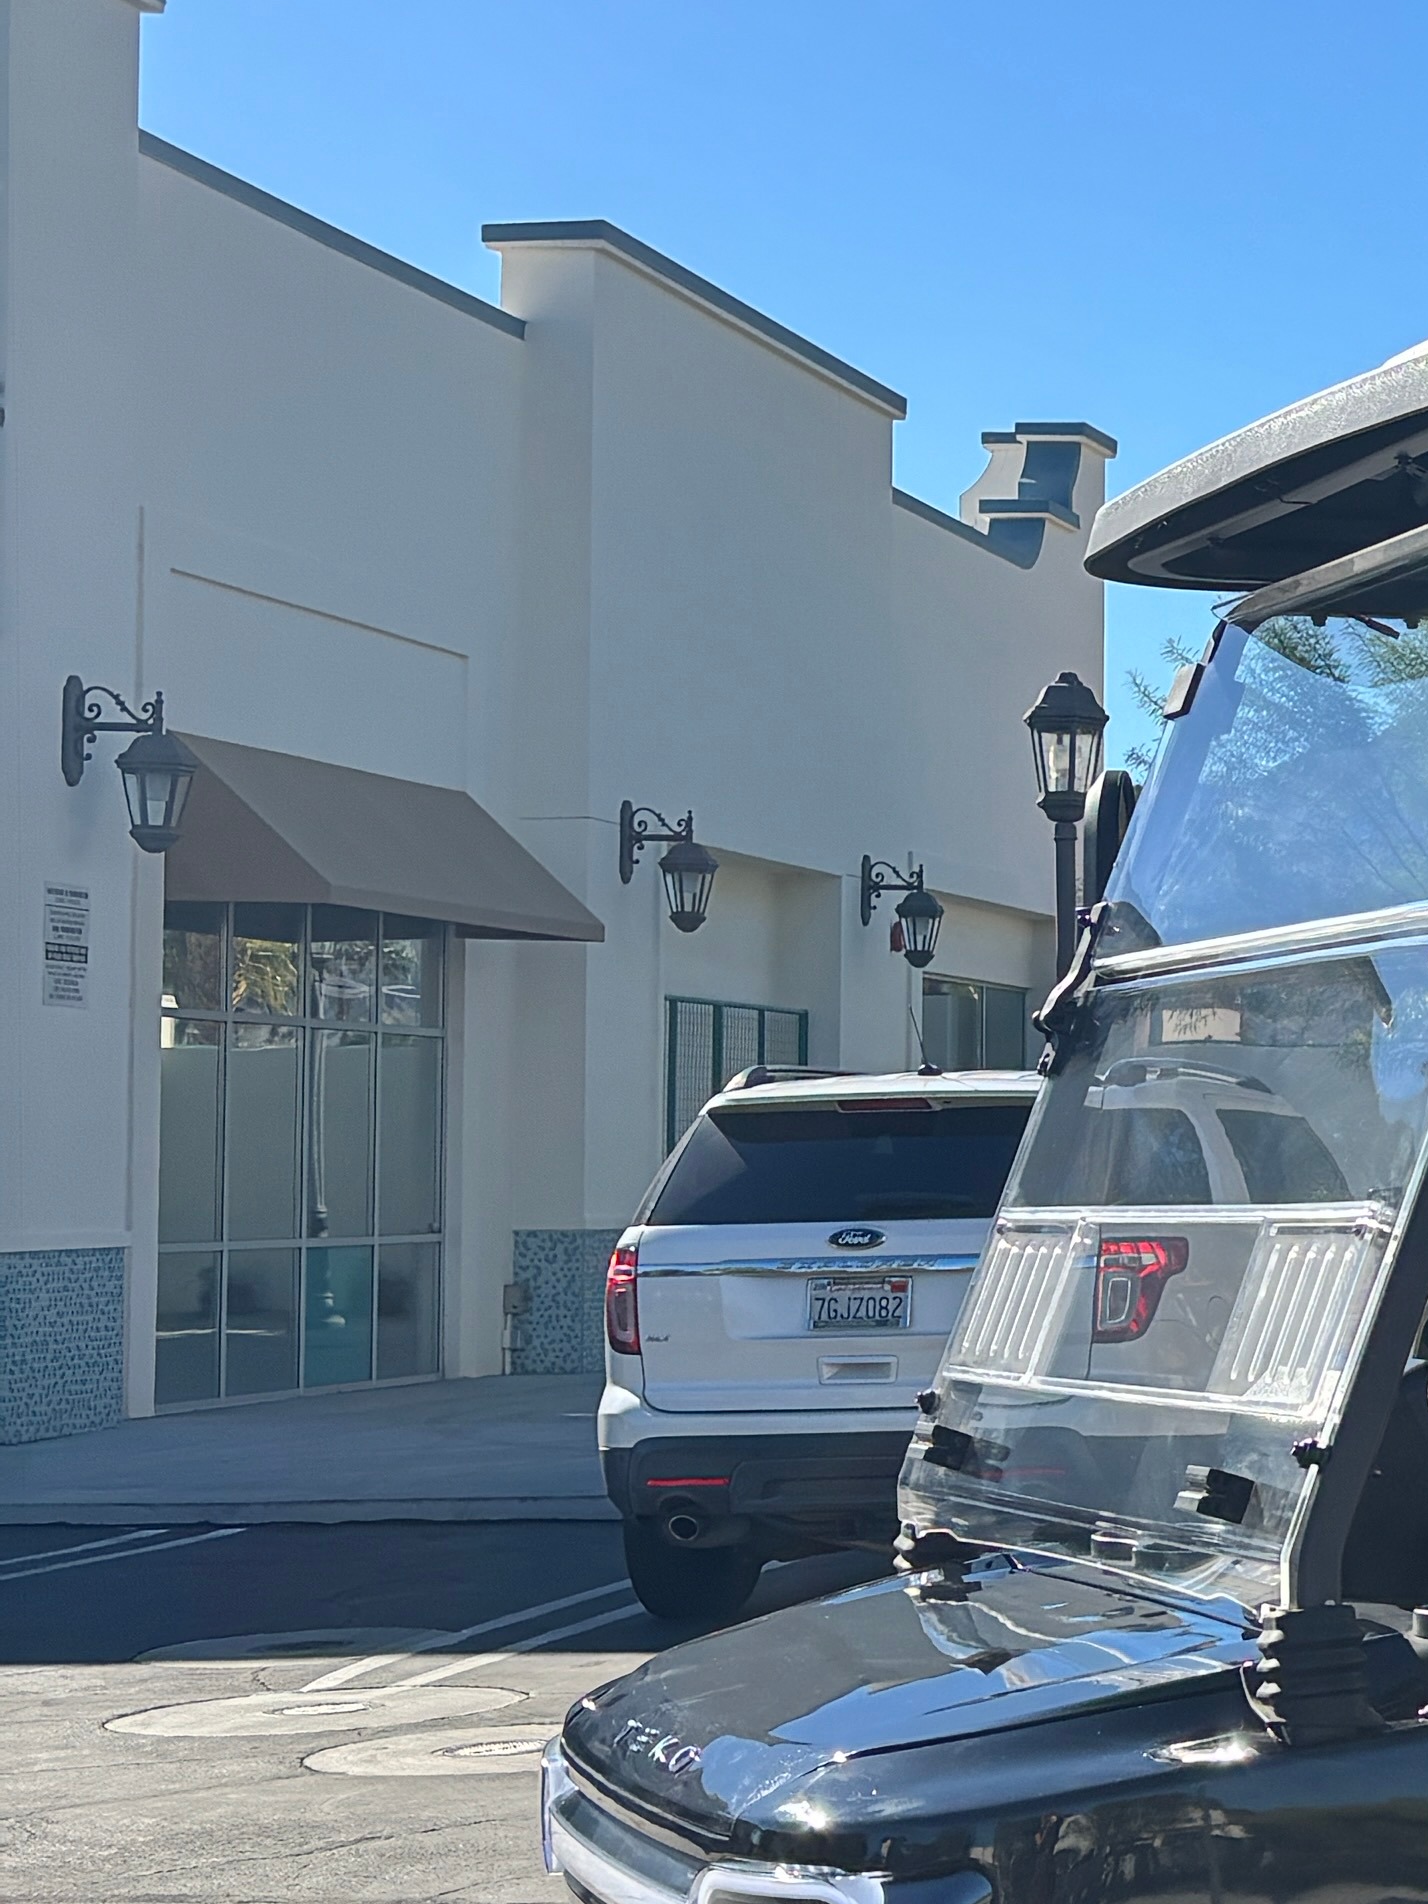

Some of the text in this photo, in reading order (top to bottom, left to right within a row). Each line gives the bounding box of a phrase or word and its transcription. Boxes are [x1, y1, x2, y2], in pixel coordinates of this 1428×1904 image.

[838, 1230, 871, 1244] Ford
[814, 1296, 903, 1320] 7GJZ082
[613, 1719, 702, 1778] TEKO
